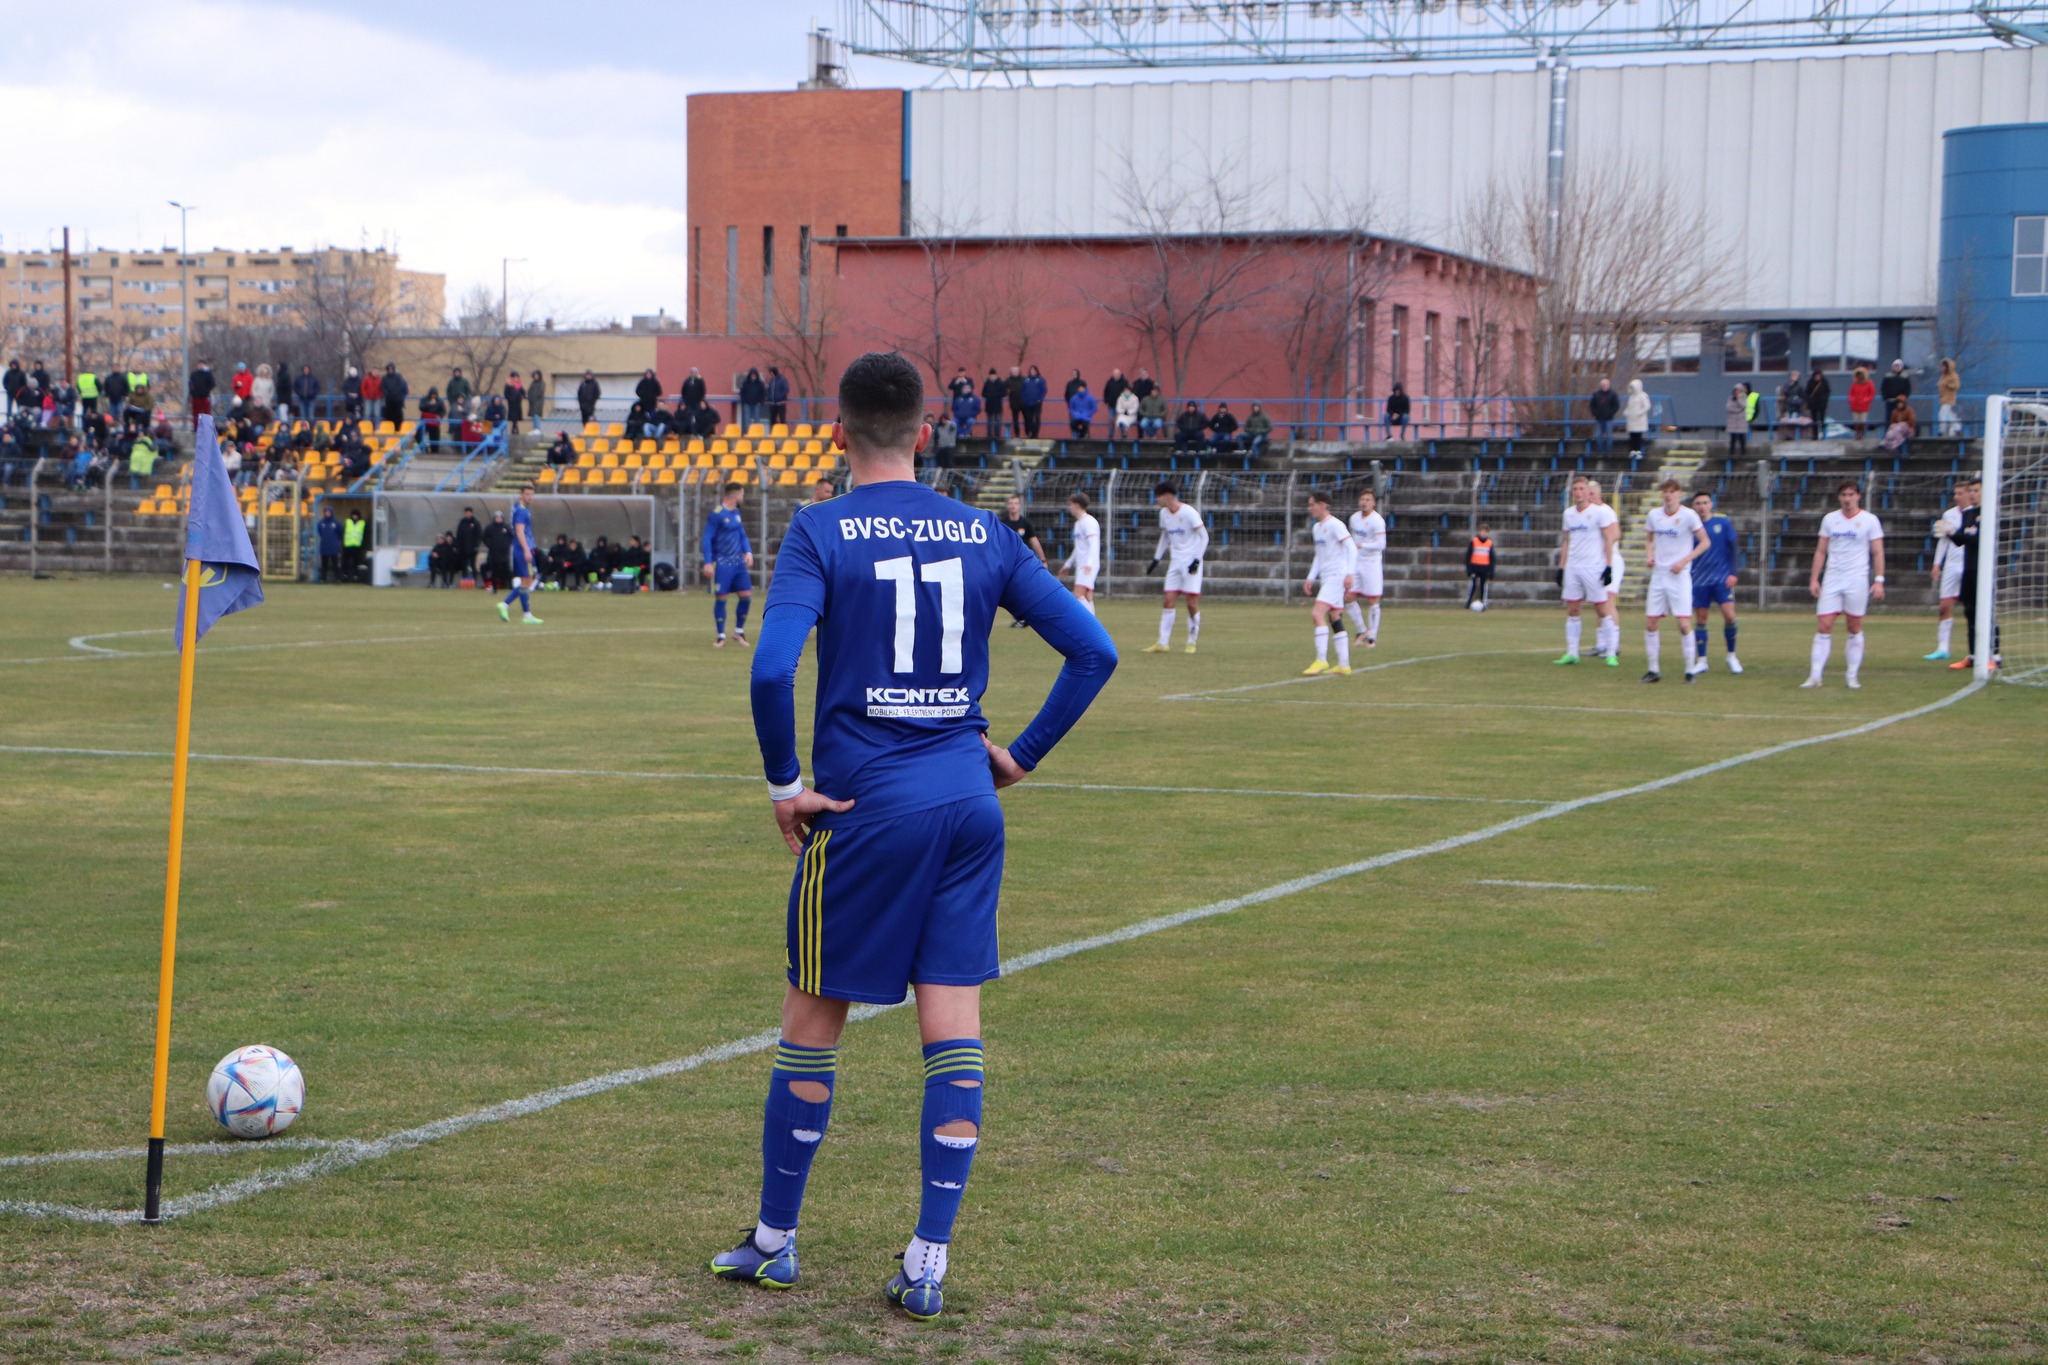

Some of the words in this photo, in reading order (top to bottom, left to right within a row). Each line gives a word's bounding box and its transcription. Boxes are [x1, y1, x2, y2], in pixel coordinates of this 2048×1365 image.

[840, 517, 987, 544] BVSC-ZUGLÓ
[874, 556, 964, 674] 11
[866, 687, 969, 703] KONTEX
